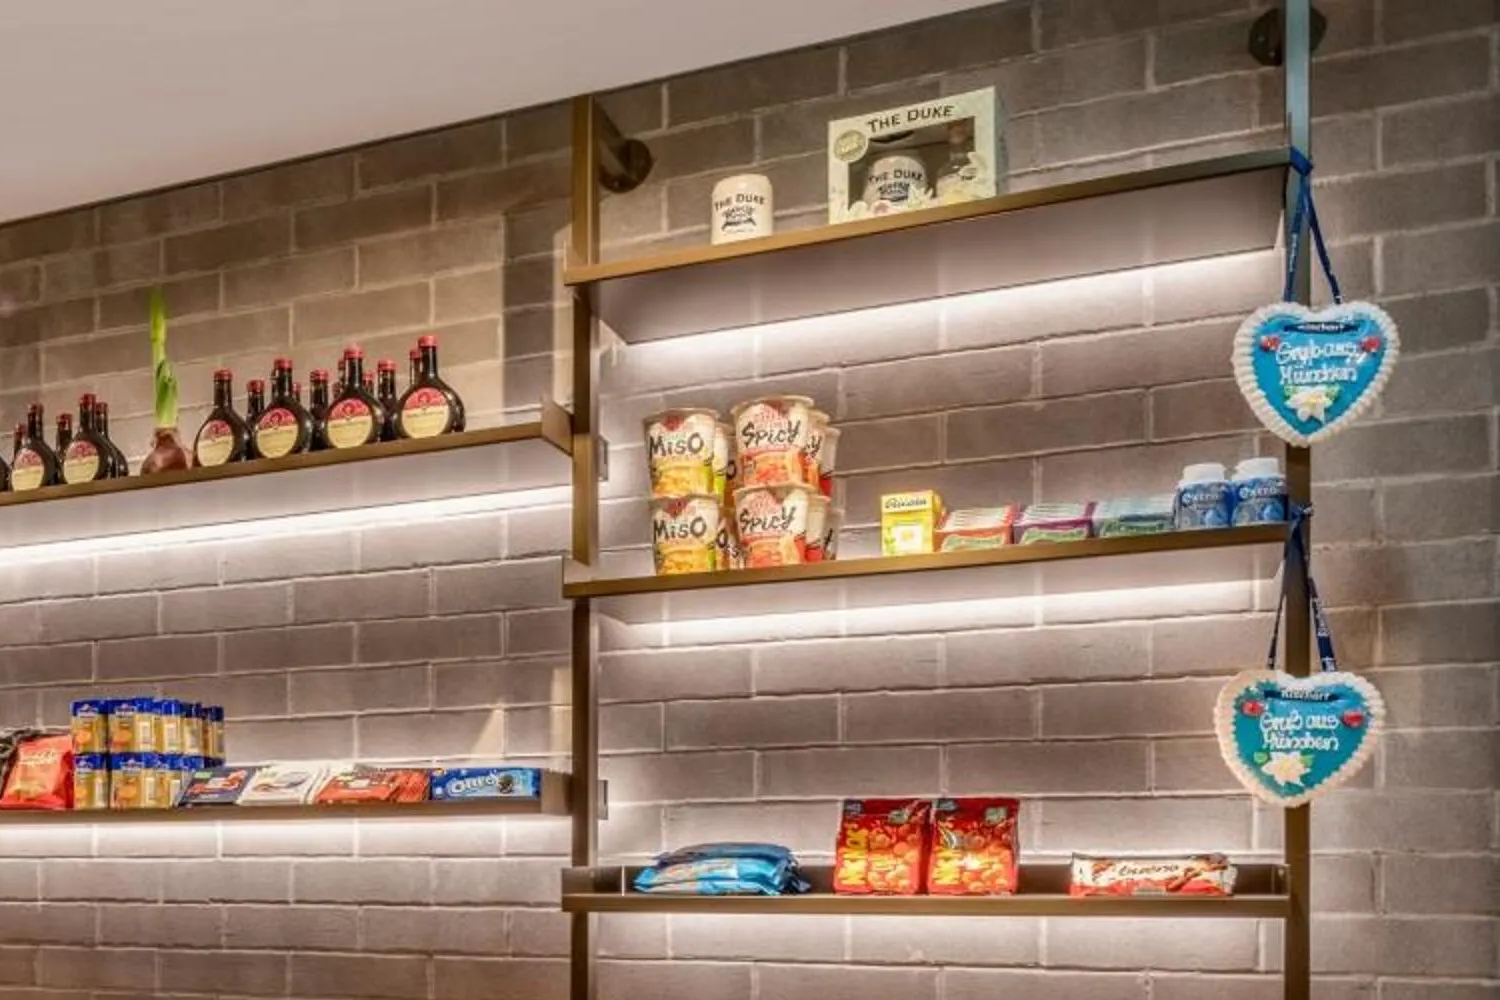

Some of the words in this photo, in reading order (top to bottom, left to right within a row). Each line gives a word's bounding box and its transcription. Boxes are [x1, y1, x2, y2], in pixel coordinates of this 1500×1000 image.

[868, 113, 901, 133] THE
[907, 105, 956, 122] DUKE
[735, 192, 766, 205] DUKE
